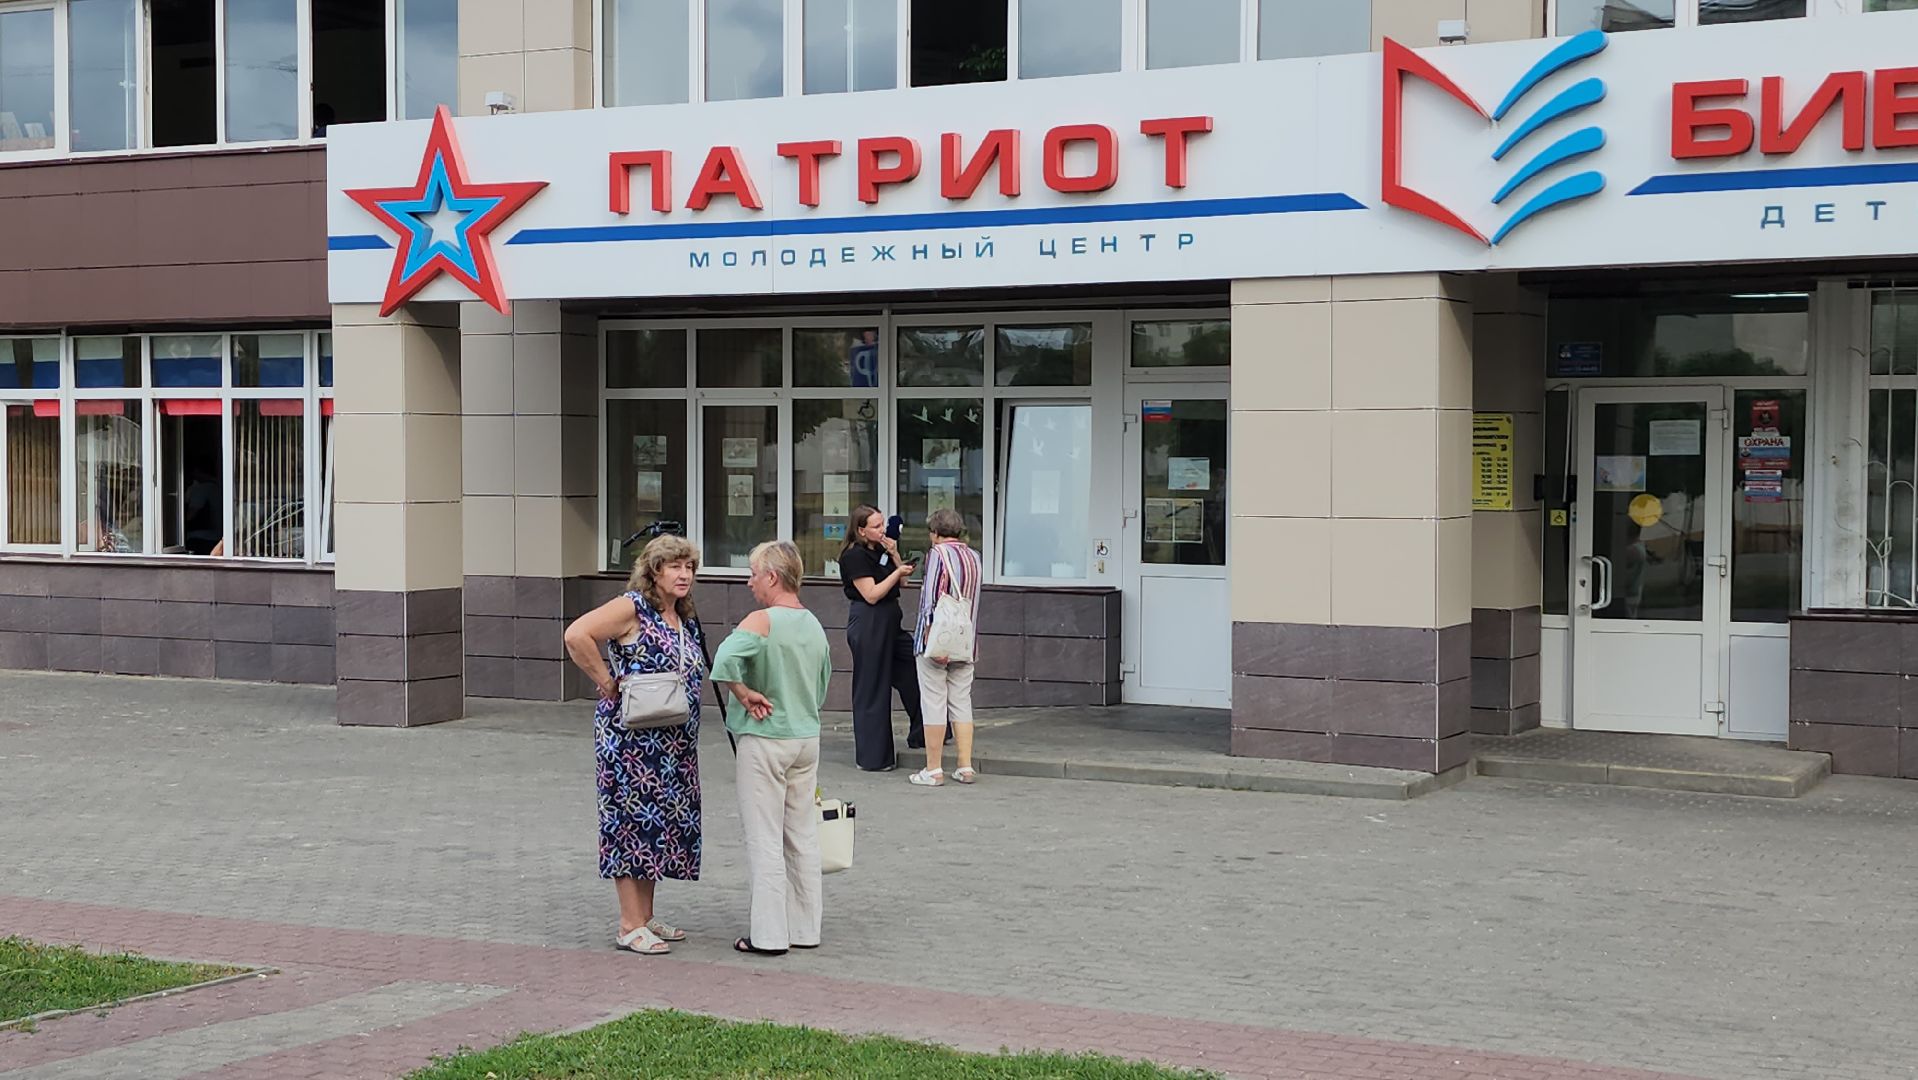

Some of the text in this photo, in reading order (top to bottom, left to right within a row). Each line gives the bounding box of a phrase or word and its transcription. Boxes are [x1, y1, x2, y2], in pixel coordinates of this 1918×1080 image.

[609, 116, 1213, 214] ПАТРИОТ
[1760, 201, 1887, 229] ДЕТ
[689, 233, 1194, 268] МОЛОДЕЖНЫЙ ЦЕНТР
[1744, 438, 1784, 446] ОХРАНА
